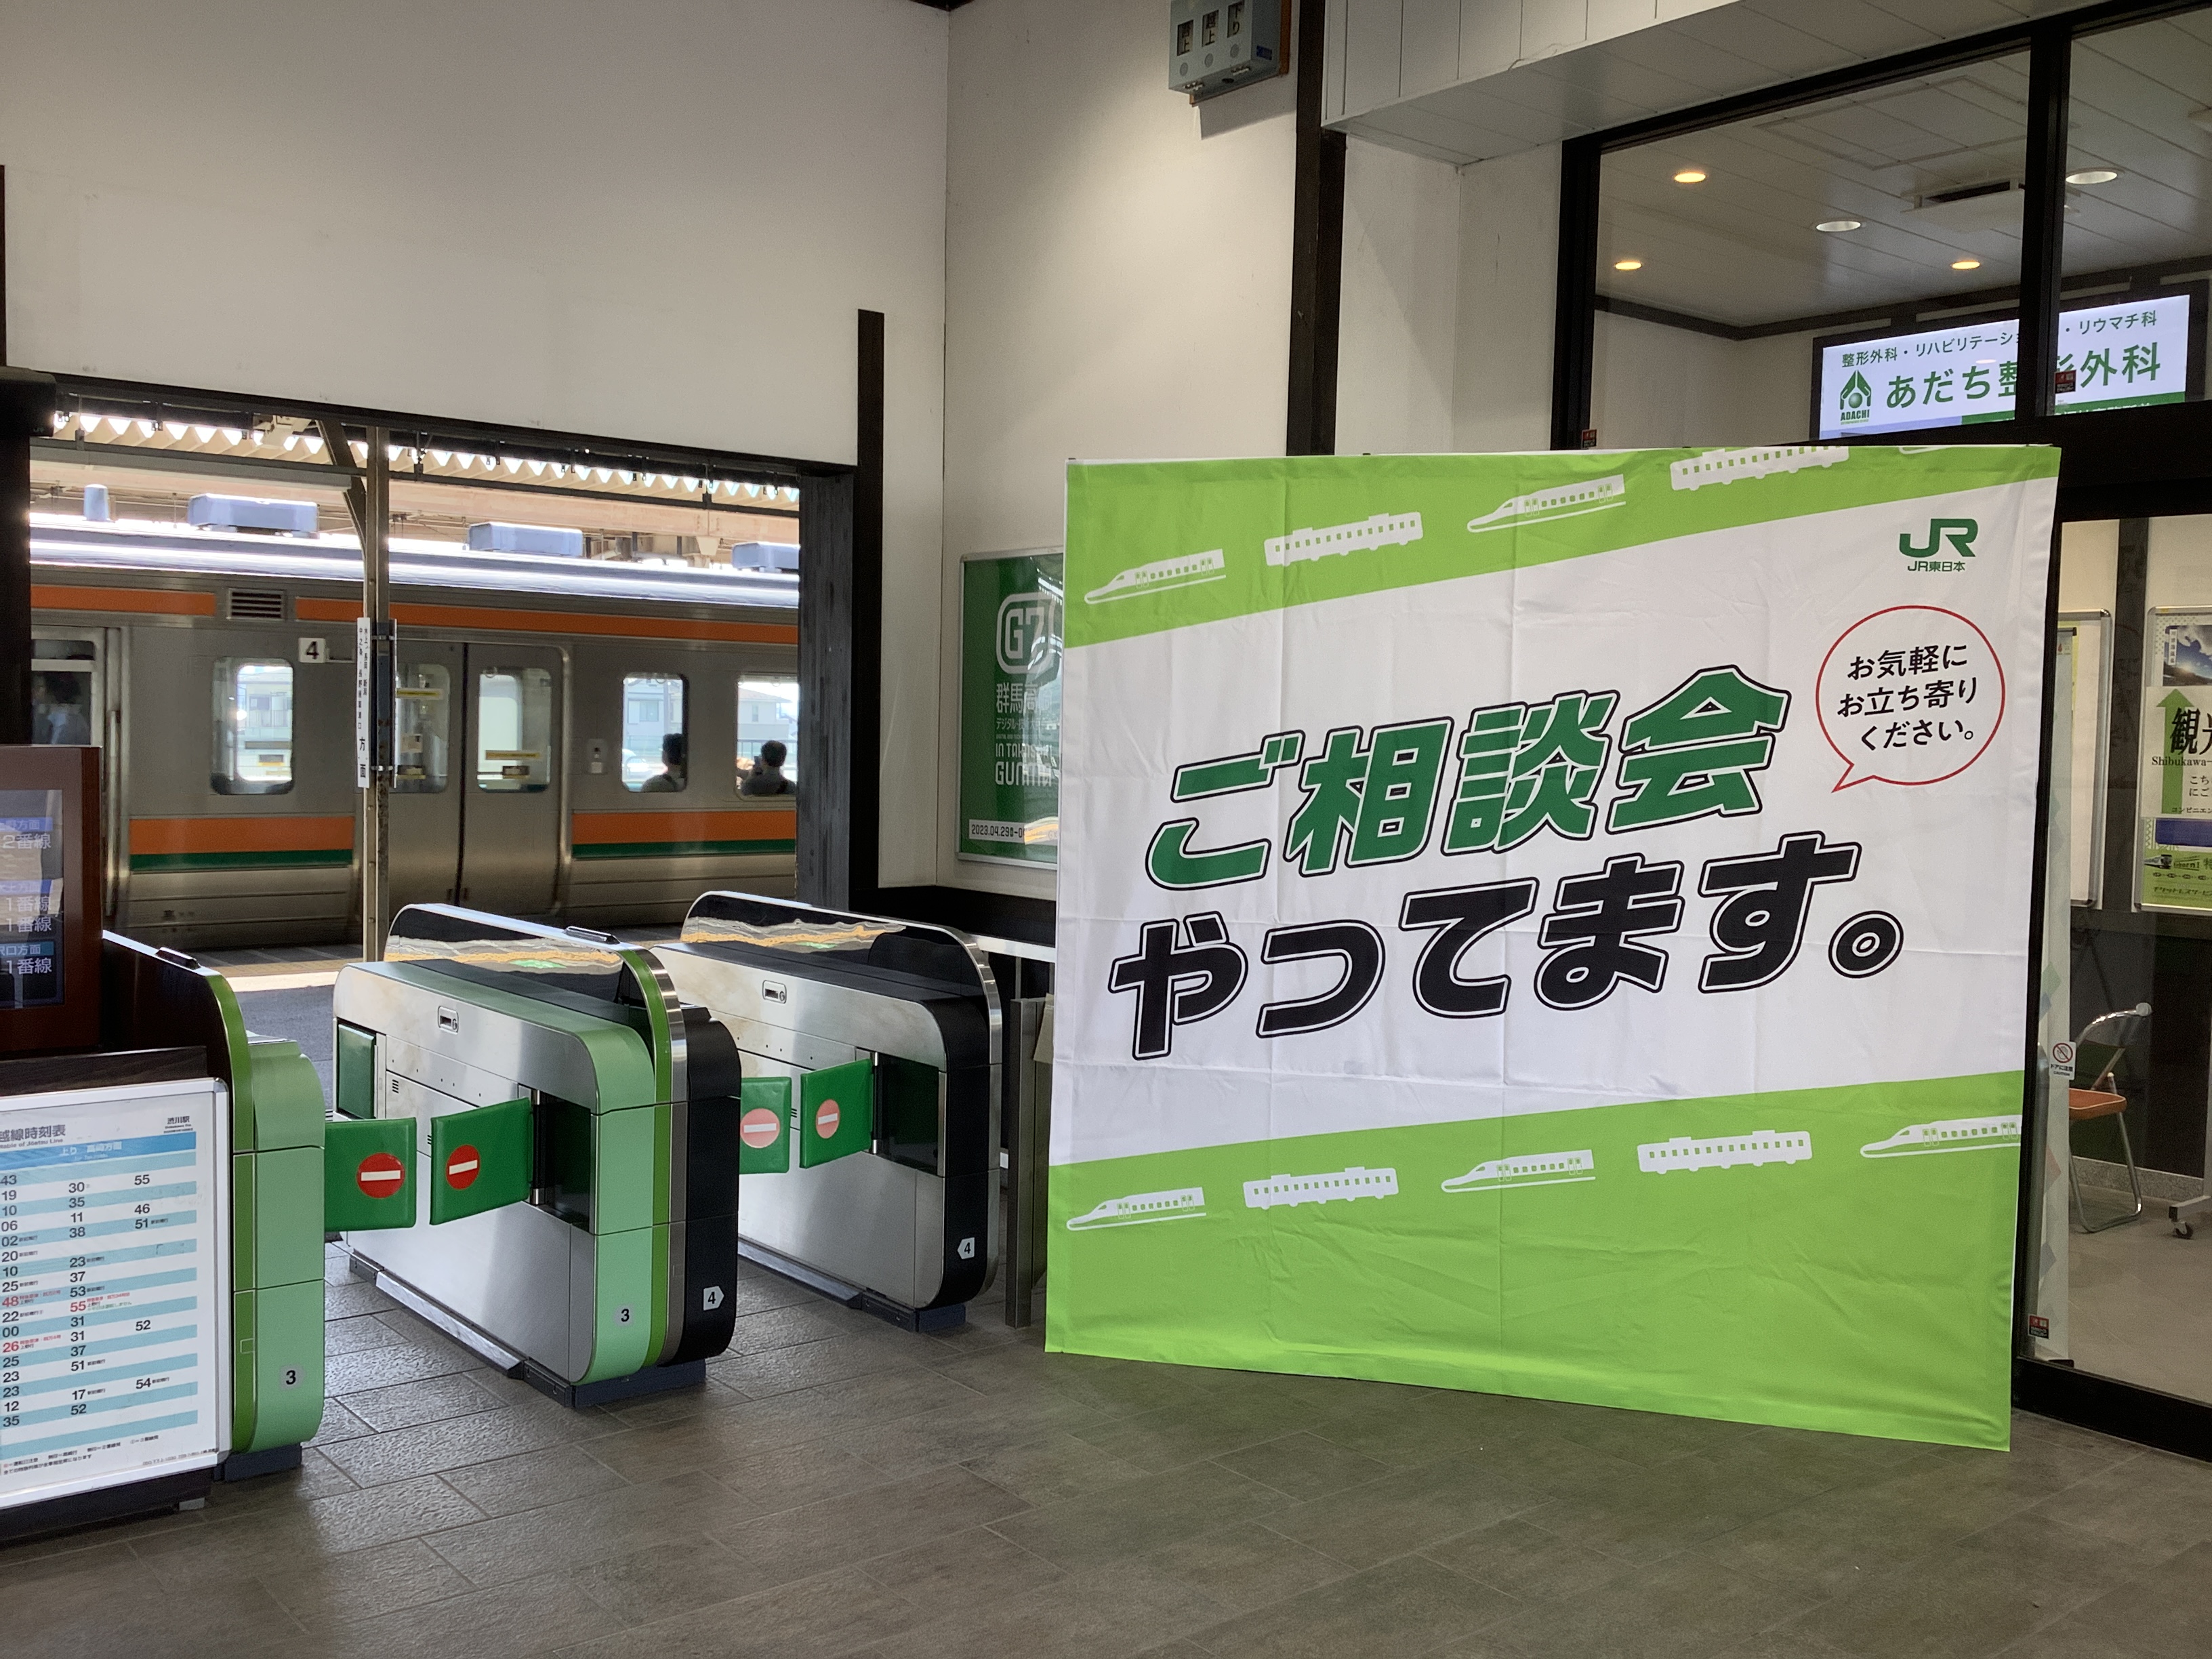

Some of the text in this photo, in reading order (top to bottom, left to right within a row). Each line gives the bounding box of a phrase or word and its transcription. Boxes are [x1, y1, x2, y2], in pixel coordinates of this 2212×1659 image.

[1841, 409, 1870, 421] ADACHI
[1899, 518, 1979, 558] JR
[1908, 560, 1966, 573] JR東日本
[1005, 607, 1044, 659] G7
[306, 641, 319, 659] 4
[1847, 644, 1967, 680] お気軽に
[1837, 677, 1978, 718] お立ち寄り
[1861, 719, 1973, 751] ください。
[1145, 664, 1792, 890] ご相談会
[6, 916, 52, 933] 1番線
[1107, 830, 1904, 1061] やってます。
[6, 958, 52, 975] 1番線
[0, 1174, 17, 1185] 43
[1, 1190, 17, 1201] 19
[68, 1182, 85, 1193] 30
[134, 1174, 150, 1185] 55
[2, 1197, 85, 1216] 10 35
[1, 1204, 150, 1232] 06 11 46
[1, 1235, 18, 1247] 02
[69, 1227, 85, 1238] 38
[135, 1218, 148, 1229] 51
[1, 1251, 18, 1263] 20
[964, 1242, 971, 1254] 4
[3, 1266, 18, 1277] 10
[69, 1256, 85, 1268] 23
[2, 1281, 19, 1292] 25
[70, 1271, 85, 1282] 37
[2, 1296, 19, 1308] 48
[70, 1286, 85, 1297] 53
[708, 1291, 716, 1304] 4
[2, 1311, 19, 1323] 22
[70, 1300, 86, 1312] 55
[621, 1309, 630, 1322] 3
[2, 1316, 84, 1338] 00 31
[3, 1341, 19, 1353] 26
[70, 1330, 85, 1342] 31
[136, 1320, 151, 1331] 52
[3, 1345, 86, 1368] 25 37
[3, 1371, 19, 1383] 23
[71, 1360, 85, 1371] 51
[286, 1370, 296, 1385] 3
[3, 1386, 19, 1398] 23
[4, 1401, 19, 1412] 12
[72, 1389, 86, 1400] 17
[136, 1378, 151, 1389] 54
[3, 1404, 87, 1427] 35 52
